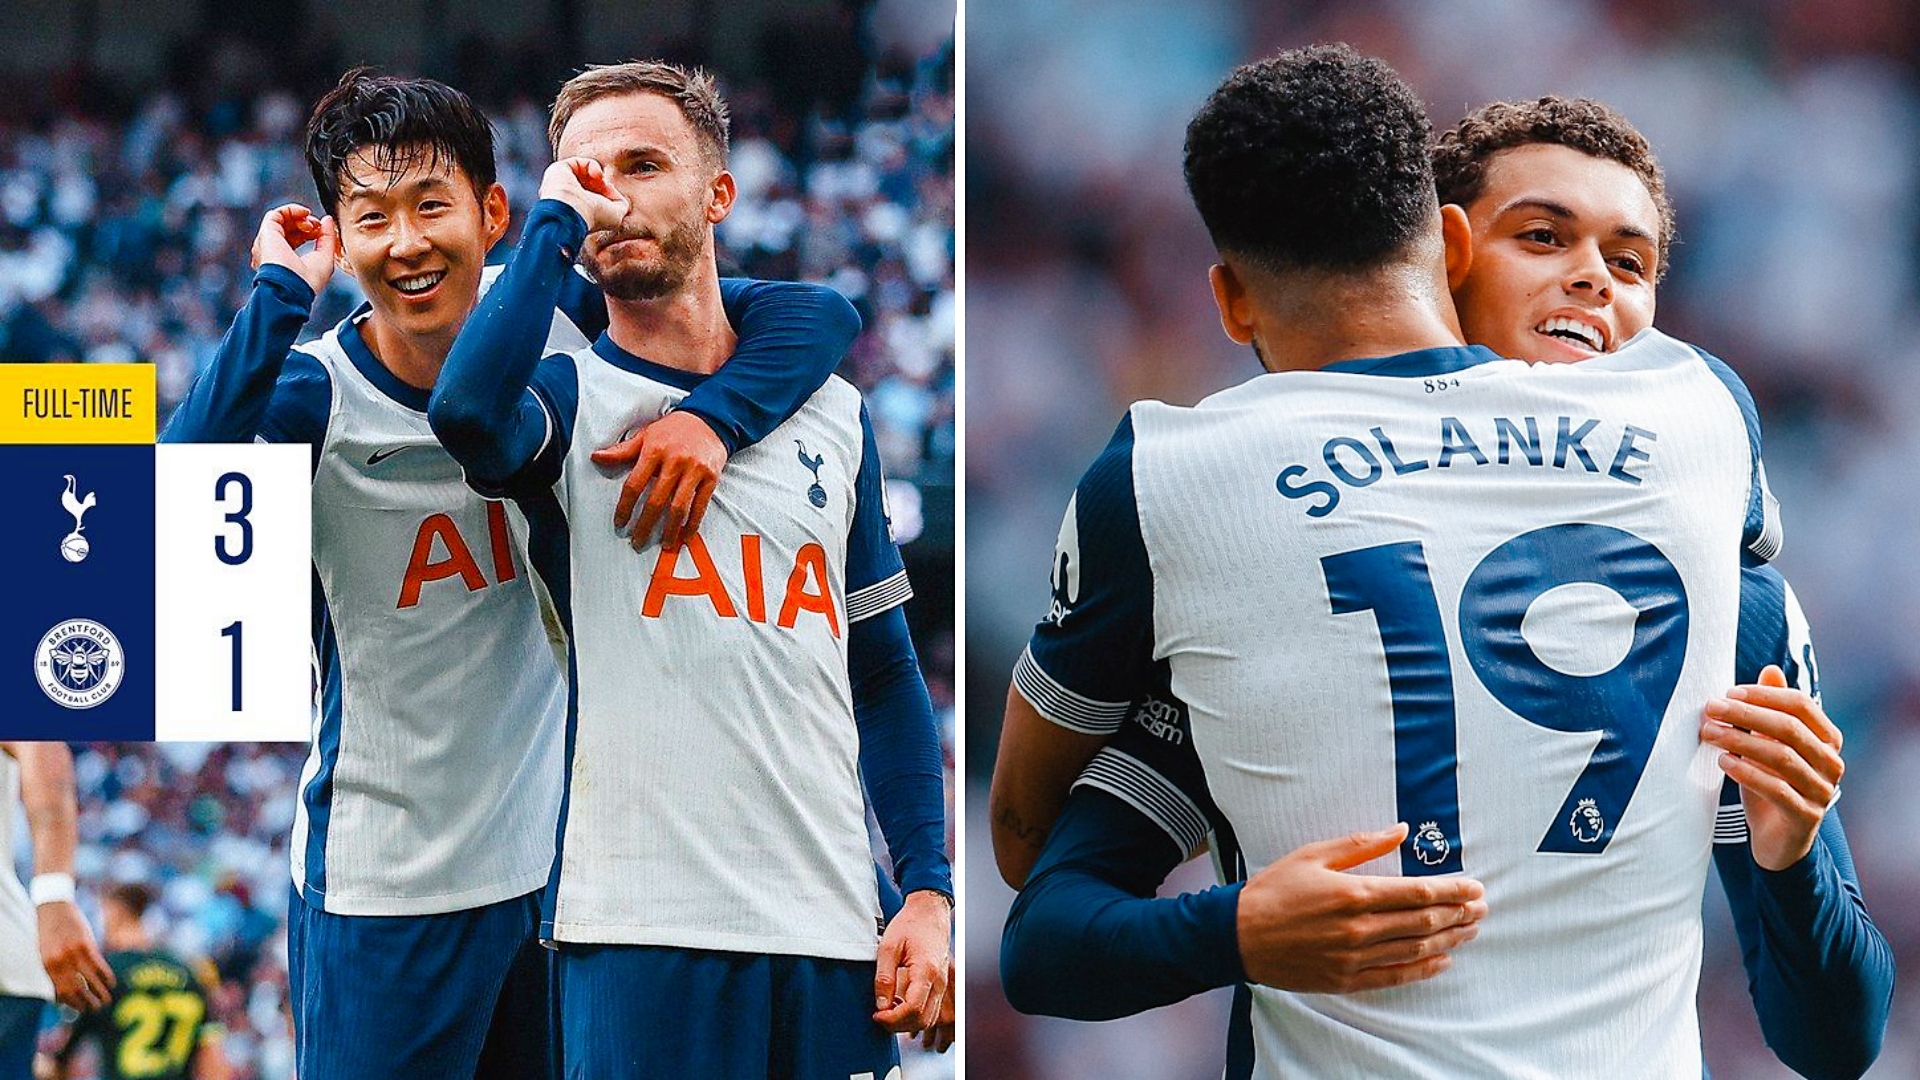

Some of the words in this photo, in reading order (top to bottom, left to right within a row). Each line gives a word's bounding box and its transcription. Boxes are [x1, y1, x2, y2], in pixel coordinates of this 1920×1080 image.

[1423, 378, 1461, 394] 884
[1276, 415, 1657, 518] SOLANKE
[396, 499, 516, 609] AI
[641, 531, 842, 640] AIA
[1319, 522, 1690, 878] 19
[115, 991, 204, 1077] 27
